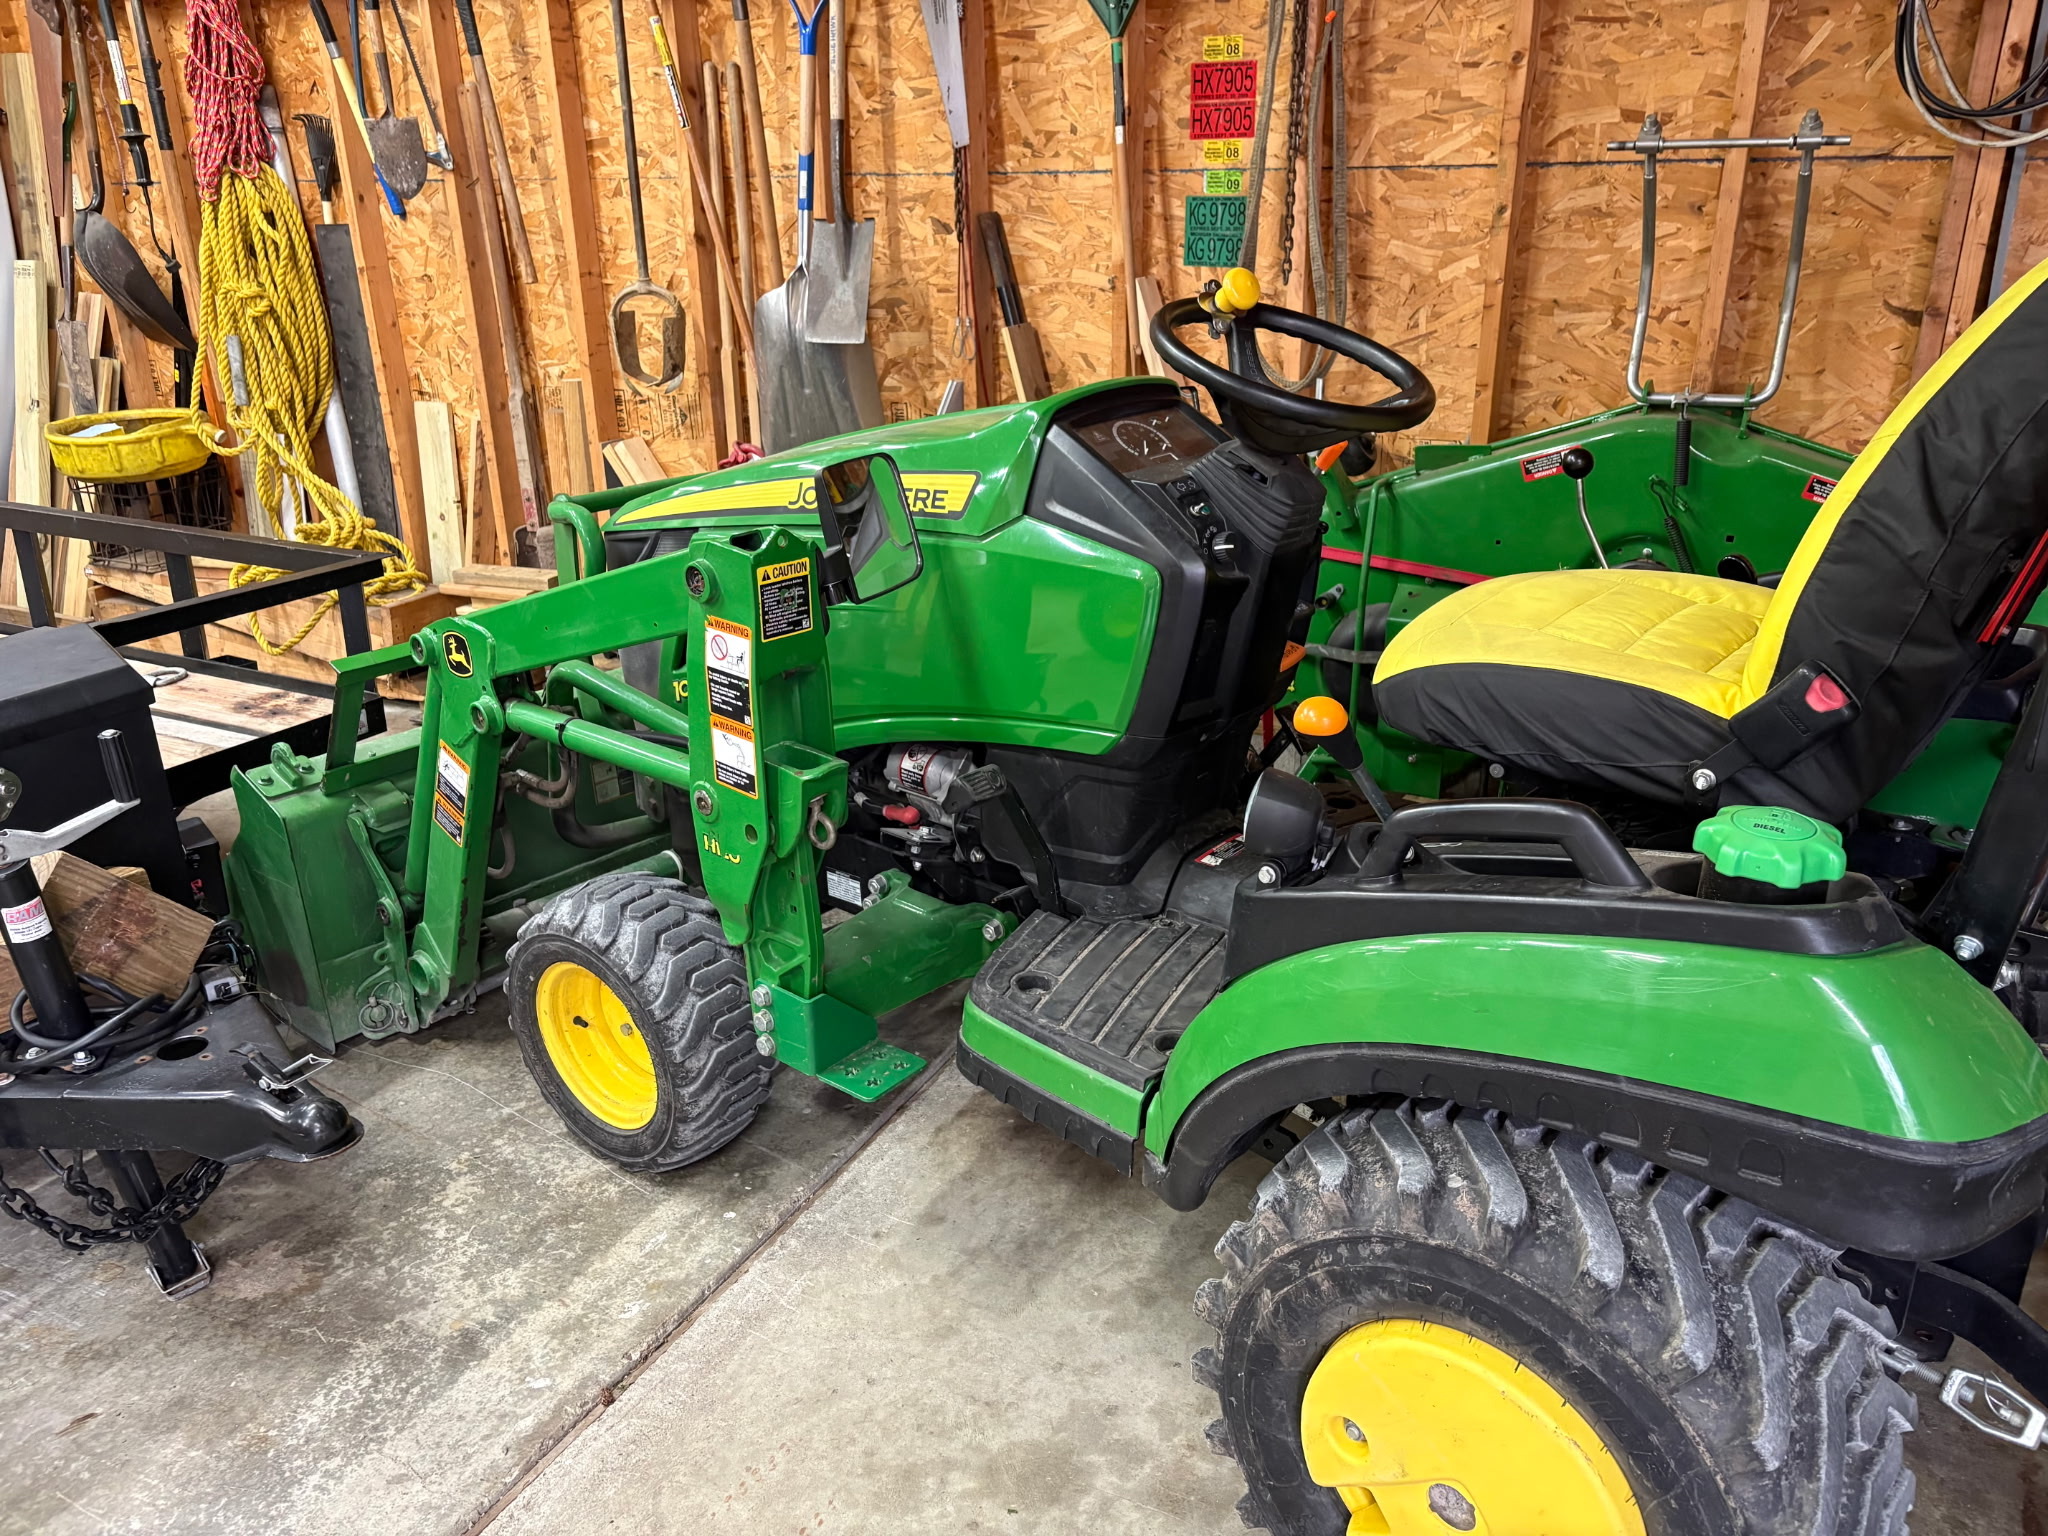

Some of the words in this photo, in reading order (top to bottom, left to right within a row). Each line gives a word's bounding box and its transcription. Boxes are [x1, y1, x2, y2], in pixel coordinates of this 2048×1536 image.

[1226, 43, 1240, 56] 08
[1193, 66, 1254, 94] HX7905
[1192, 106, 1252, 133] HX7905
[1226, 147, 1239, 158] 08
[1226, 178, 1240, 190] 09
[1189, 202, 1207, 226] KG
[1209, 202, 1246, 226] 9798
[1187, 237, 1205, 261] KG
[788, 482, 817, 506] JO
[772, 560, 807, 579] CAUTION
[713, 619, 749, 638] WARNING
[718, 720, 752, 740] WARNING
[1752, 822, 1786, 835] DIESEL
